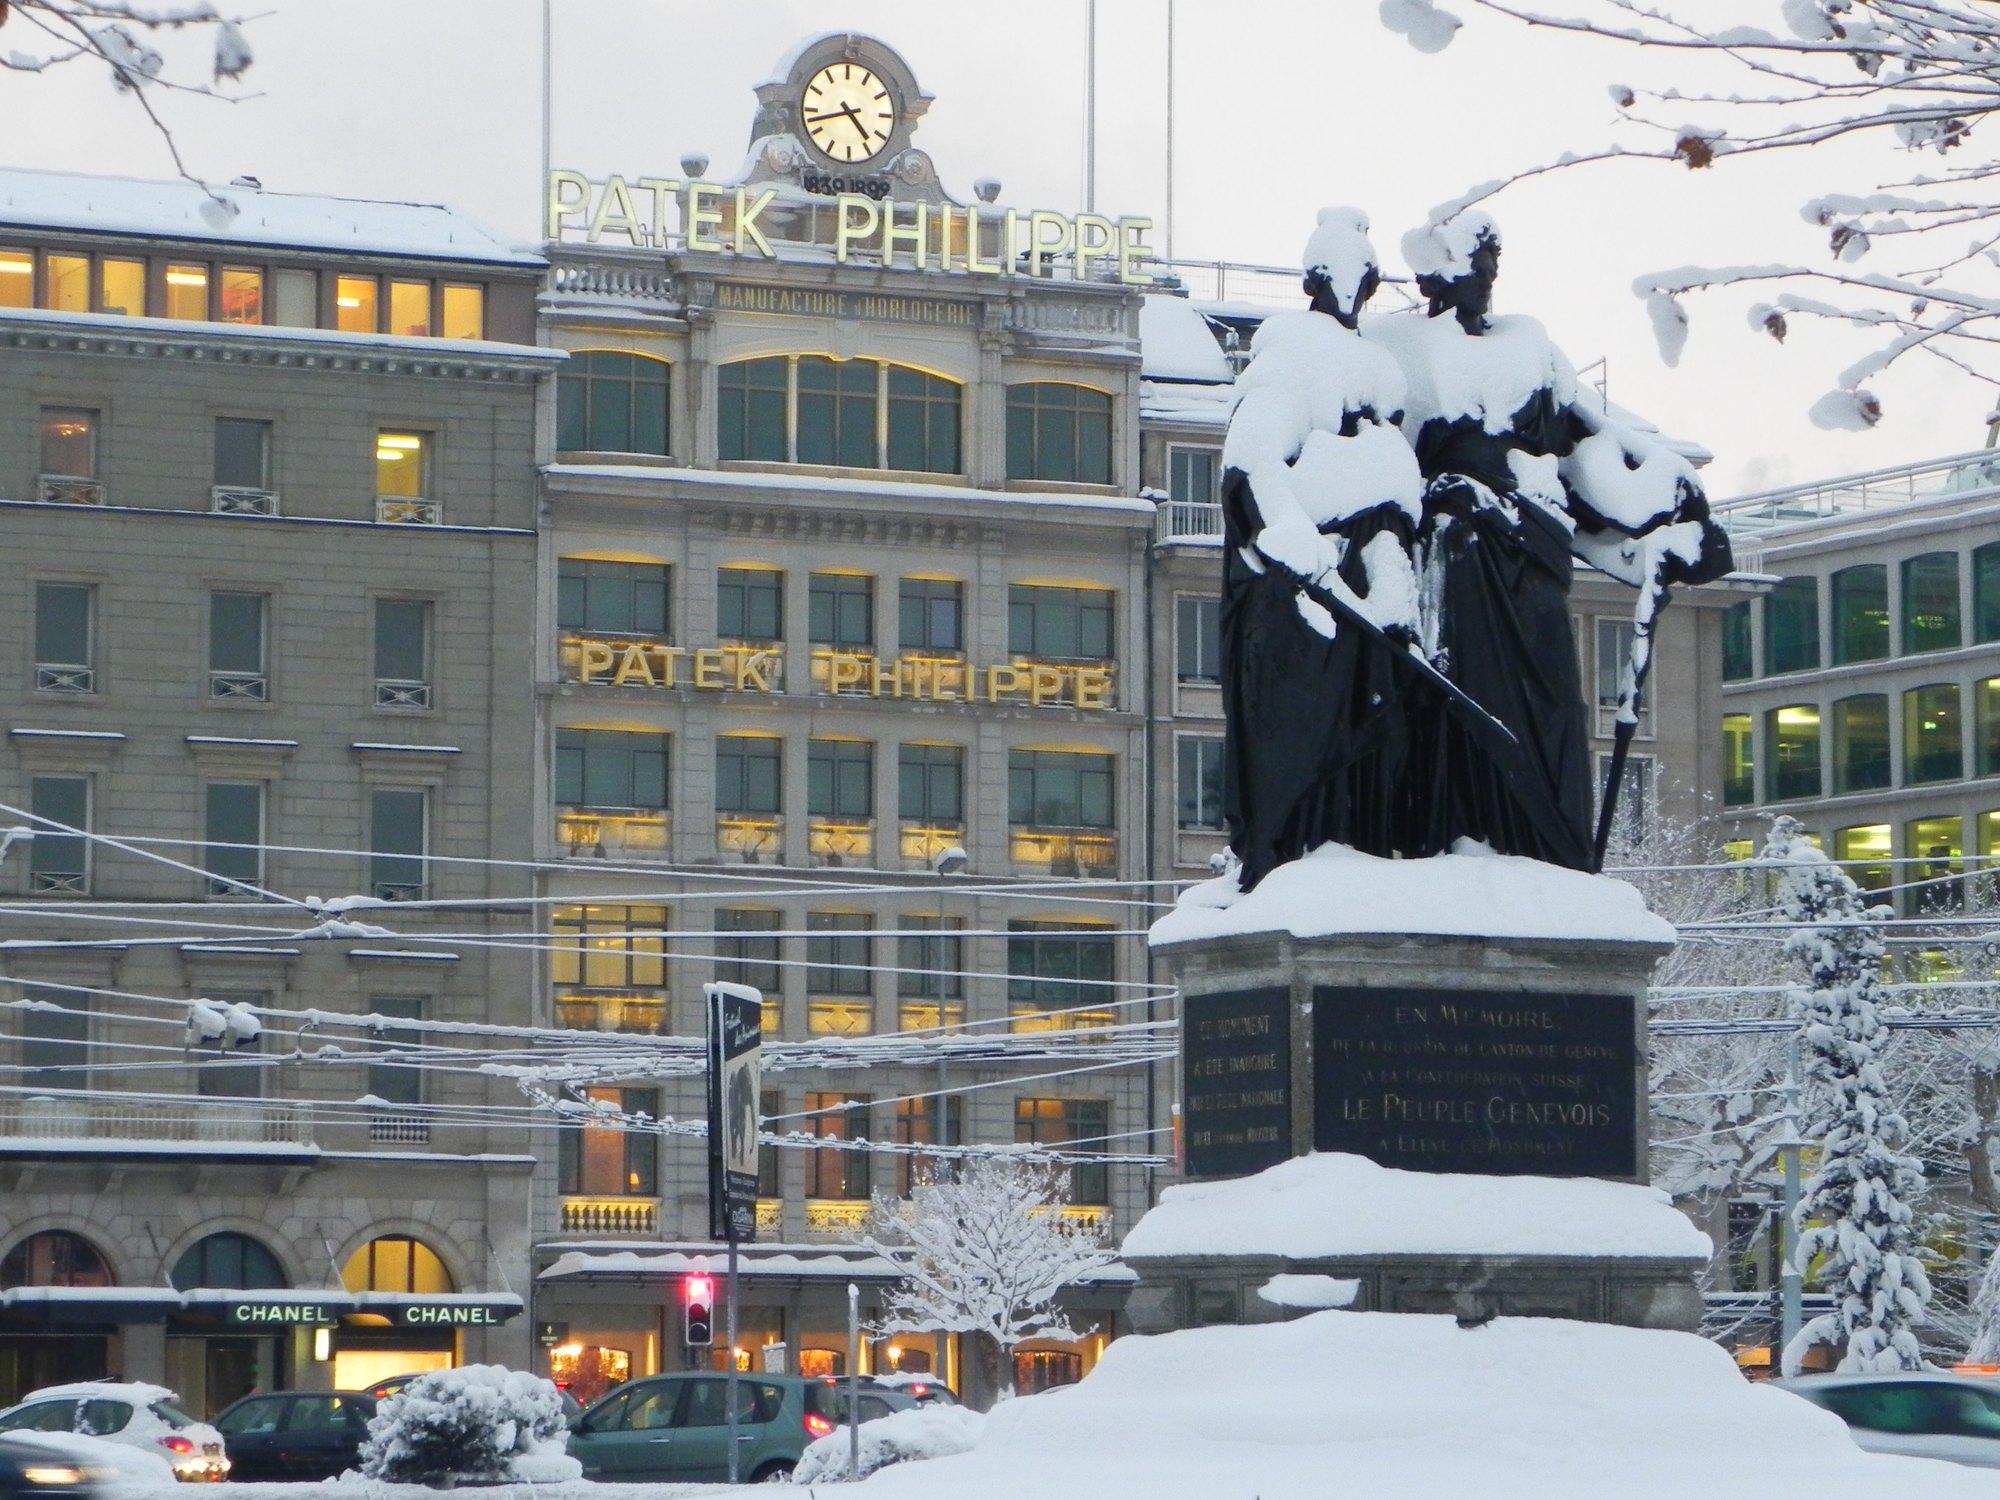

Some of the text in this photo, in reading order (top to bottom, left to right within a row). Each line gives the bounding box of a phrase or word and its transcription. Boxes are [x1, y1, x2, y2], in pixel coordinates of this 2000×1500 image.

[547, 169, 1154, 285] PATEK PHILIPPE
[718, 285, 848, 316] MANUFACTURE
[579, 643, 1105, 708] PATEK PHILIPPE
[1395, 1006, 1427, 1024] EN
[1343, 1097, 1372, 1121] LE
[1487, 1096, 1611, 1126] GENEVOIS
[235, 1304, 330, 1322] CHANEL
[405, 1306, 498, 1324] CHANEL
